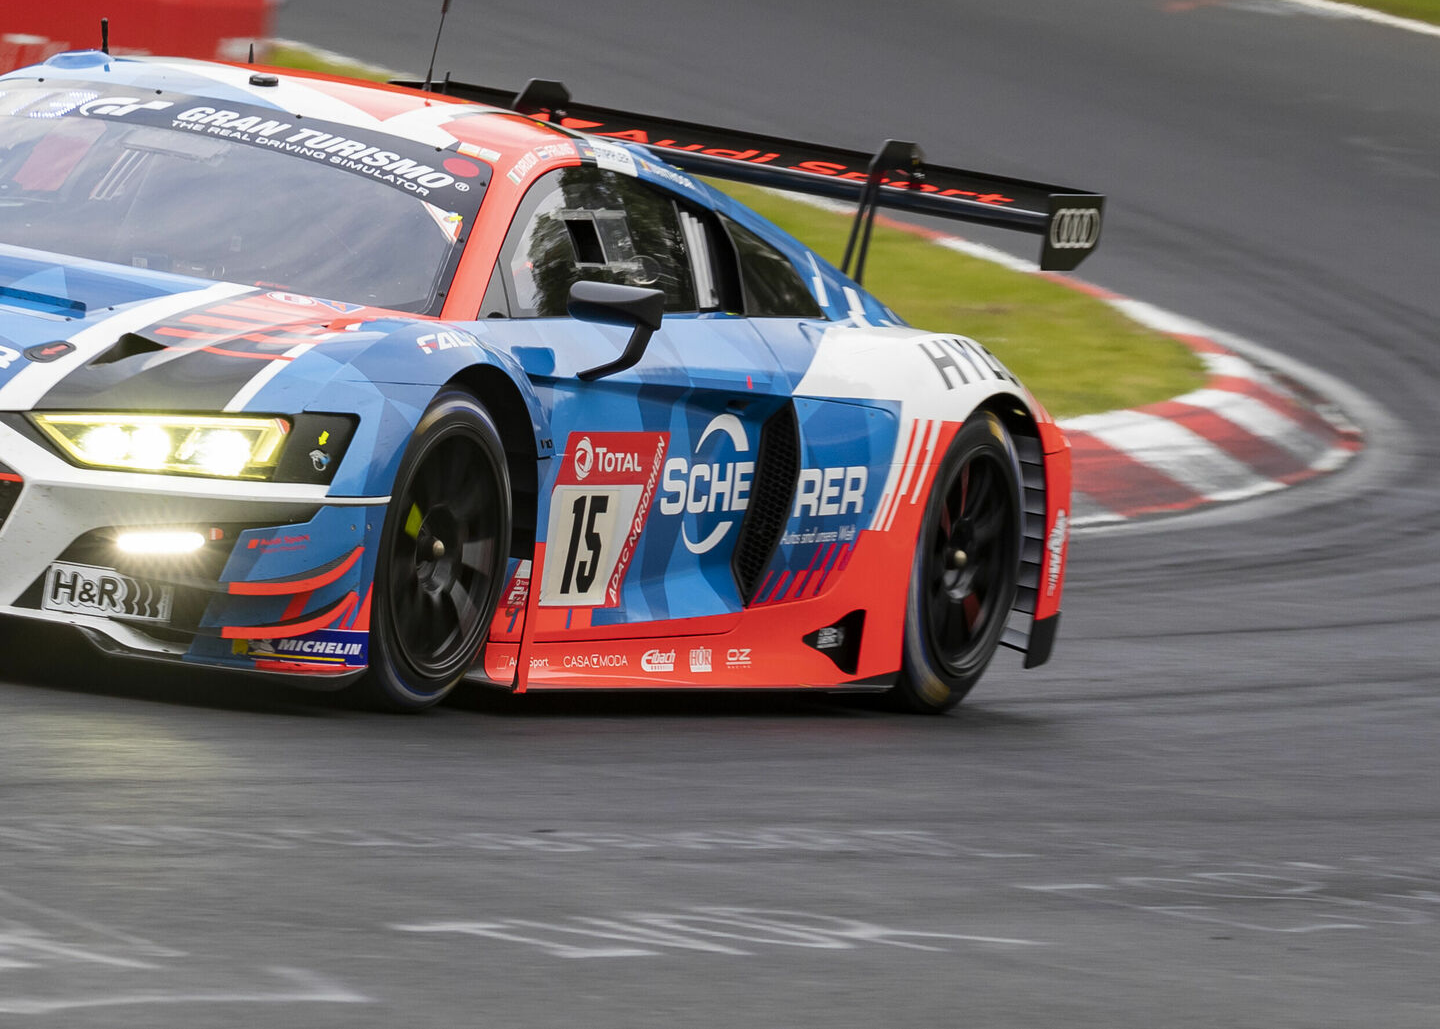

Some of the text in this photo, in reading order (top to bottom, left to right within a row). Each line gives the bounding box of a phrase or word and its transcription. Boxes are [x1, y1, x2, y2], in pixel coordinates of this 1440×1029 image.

[171, 119, 431, 197] THE REAL DRIVING SIMULATOR
[176, 106, 455, 190] GRAN TURISMO
[416, 332, 472, 355] FAL
[595, 447, 642, 472] TOTAL
[609, 436, 666, 604] ADAC NORDRHEIN
[560, 495, 609, 594] 15
[51, 571, 120, 608] H&R
[278, 639, 362, 655] MICHELIN
[727, 648, 752, 661] OZ
